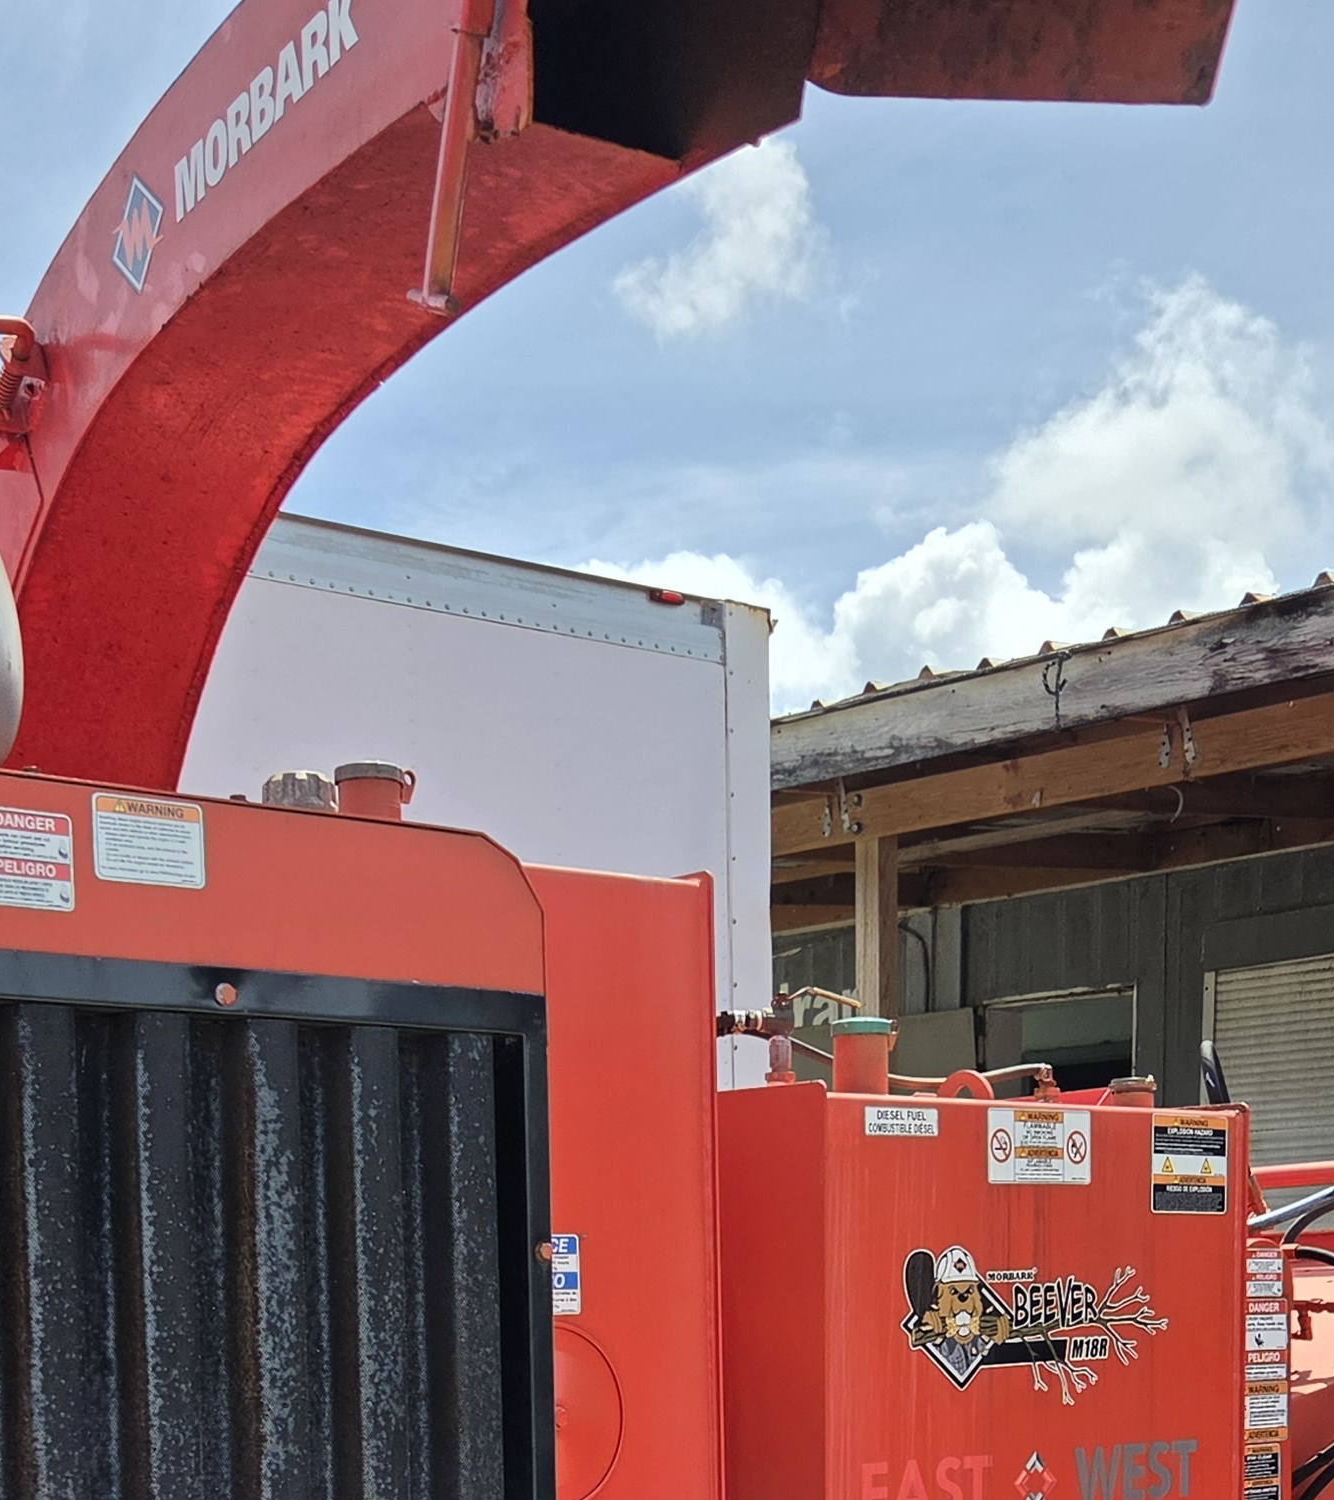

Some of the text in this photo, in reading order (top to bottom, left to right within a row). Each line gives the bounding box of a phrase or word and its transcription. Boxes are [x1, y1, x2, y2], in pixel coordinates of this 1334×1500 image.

[174, 0, 359, 223] MORBARK
[126, 801, 184, 819] WARNING
[876, 1110, 927, 1121] DIESEL FUEL
[1027, 1113, 1059, 1121] WARNING
[868, 1122, 912, 1134] COMBUSTIBLE
[1179, 1119, 1209, 1127] WARNING
[987, 1271, 1033, 1281] MORBARK
[1013, 1277, 1098, 1328] BEEVER
[1248, 1302, 1280, 1313] DANGER
[1071, 1338, 1108, 1359] M18R
[1247, 1352, 1280, 1364] PELIGRO
[1248, 1384, 1280, 1393] WARNING
